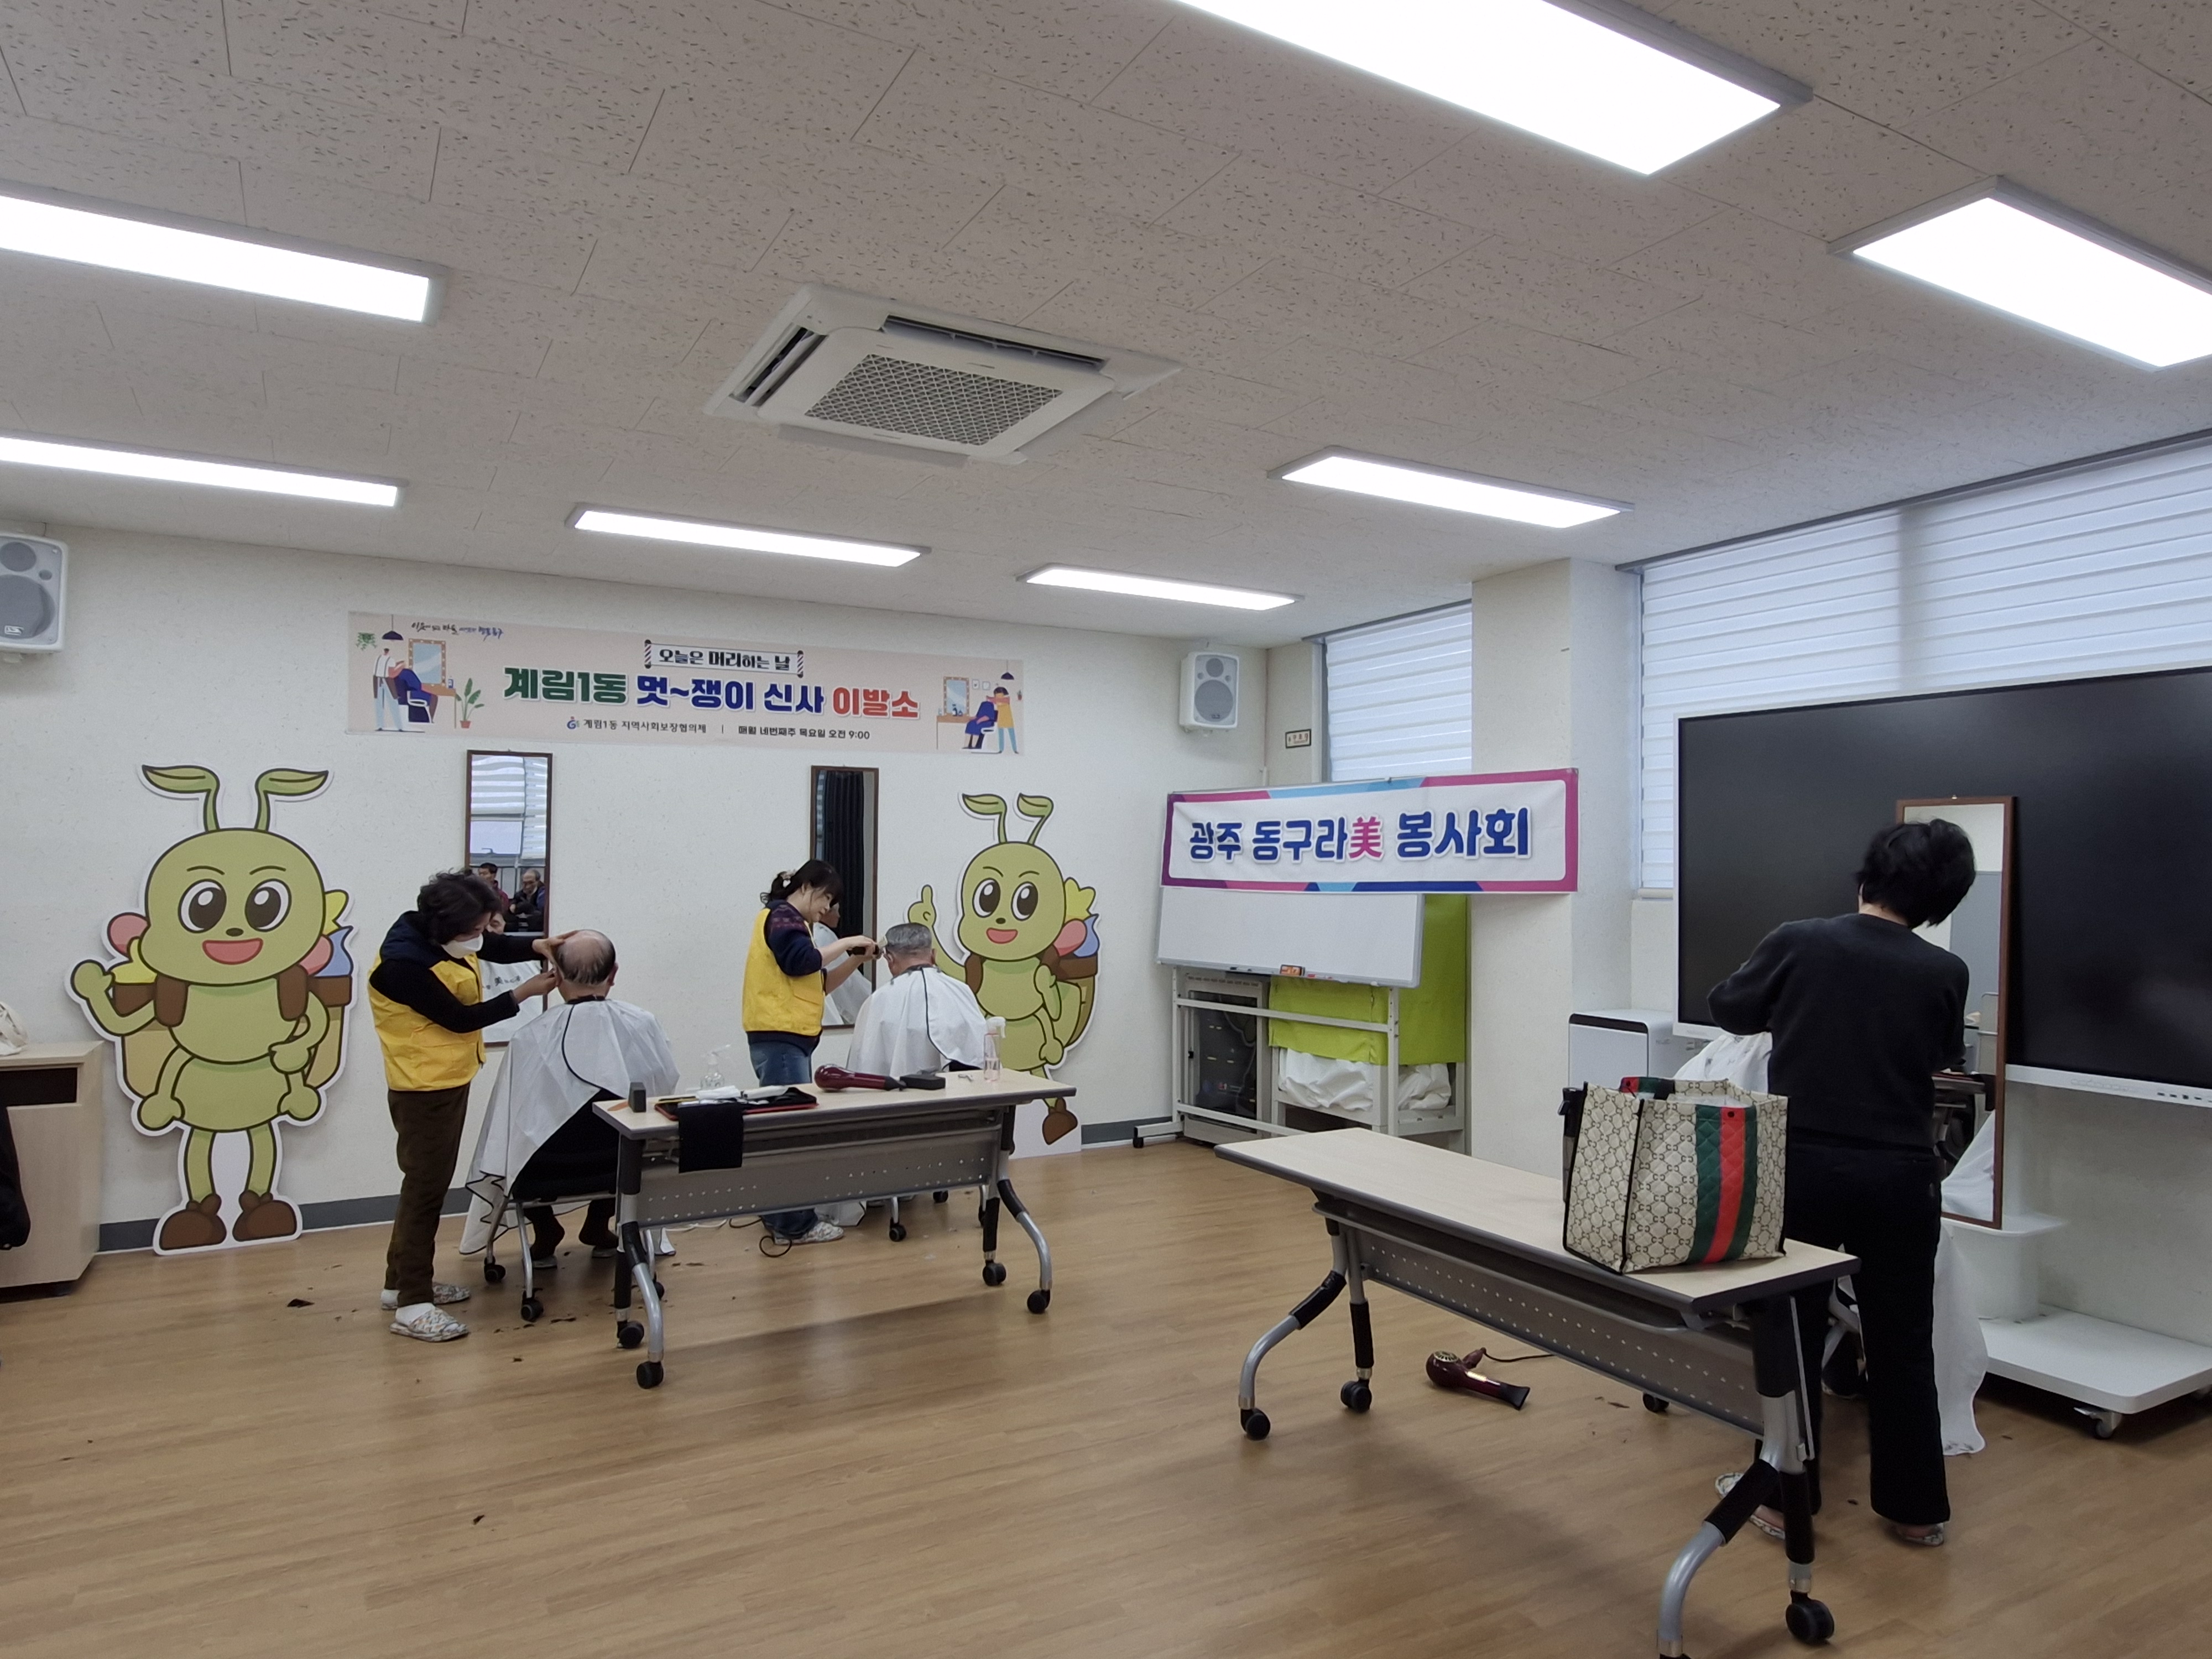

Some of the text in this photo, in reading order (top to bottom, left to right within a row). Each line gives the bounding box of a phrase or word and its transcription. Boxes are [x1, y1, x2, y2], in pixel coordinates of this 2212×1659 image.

[659, 649, 790, 671] 오늘은 머리하는 날
[504, 667, 919, 718] 계림1동 멋~쟁이 신사 이발소
[583, 719, 707, 734] 계림1동 지역사회보장협의체
[738, 726, 757, 735] 매월
[800, 728, 826, 738] 목요일
[828, 729, 846, 739] 오전
[848, 730, 870, 740] 9:00
[1190, 807, 1528, 861] 광주 동구라美 봉사회
